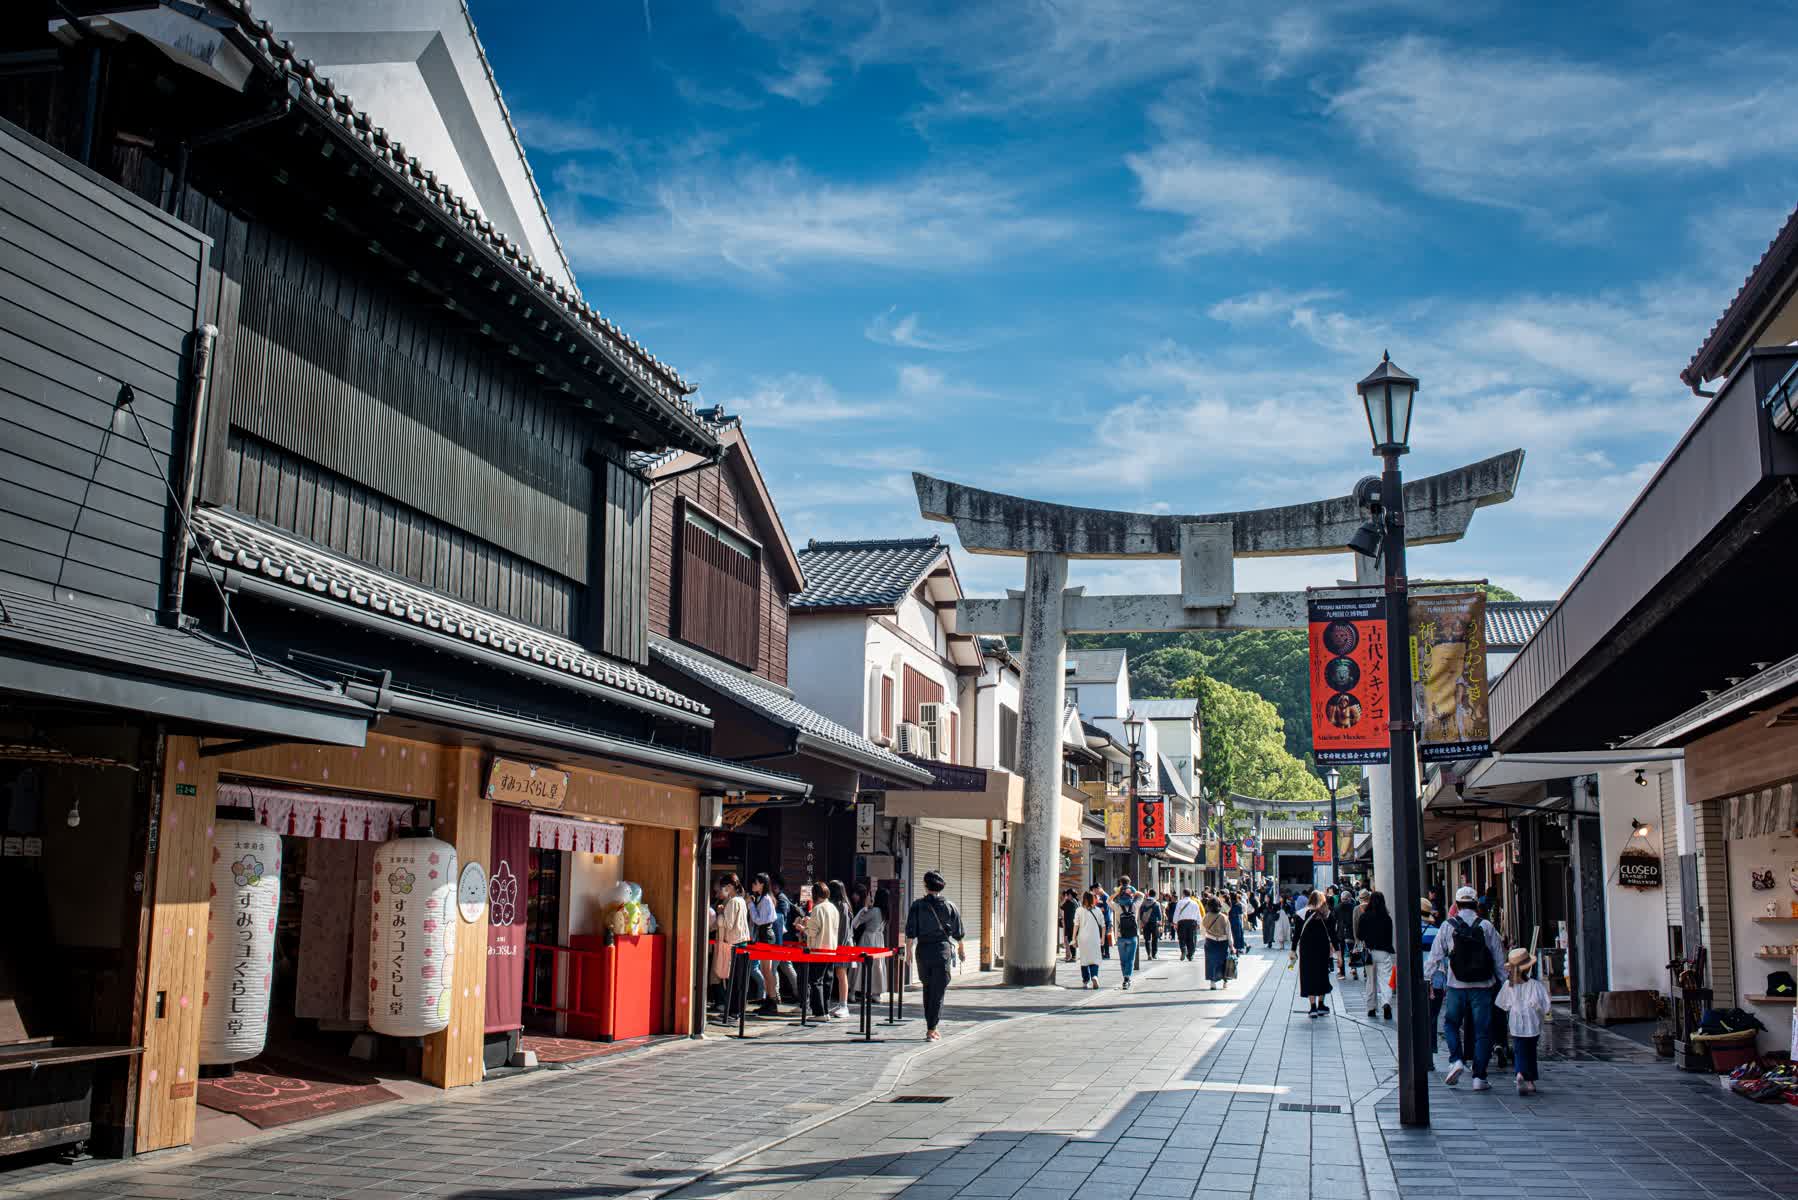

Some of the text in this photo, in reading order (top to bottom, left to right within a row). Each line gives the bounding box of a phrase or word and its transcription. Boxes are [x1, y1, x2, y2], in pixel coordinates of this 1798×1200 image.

[1326, 610, 1369, 618] 九州国立博物館
[1368, 625, 1384, 720] 古代メキシコ
[500, 774, 559, 799] すみっコぐらし堂
[1620, 864, 1658, 875] CLOSED
[227, 892, 254, 1035] すみっコぐらし堂
[388, 898, 408, 1016] すみっコぐらし堂
